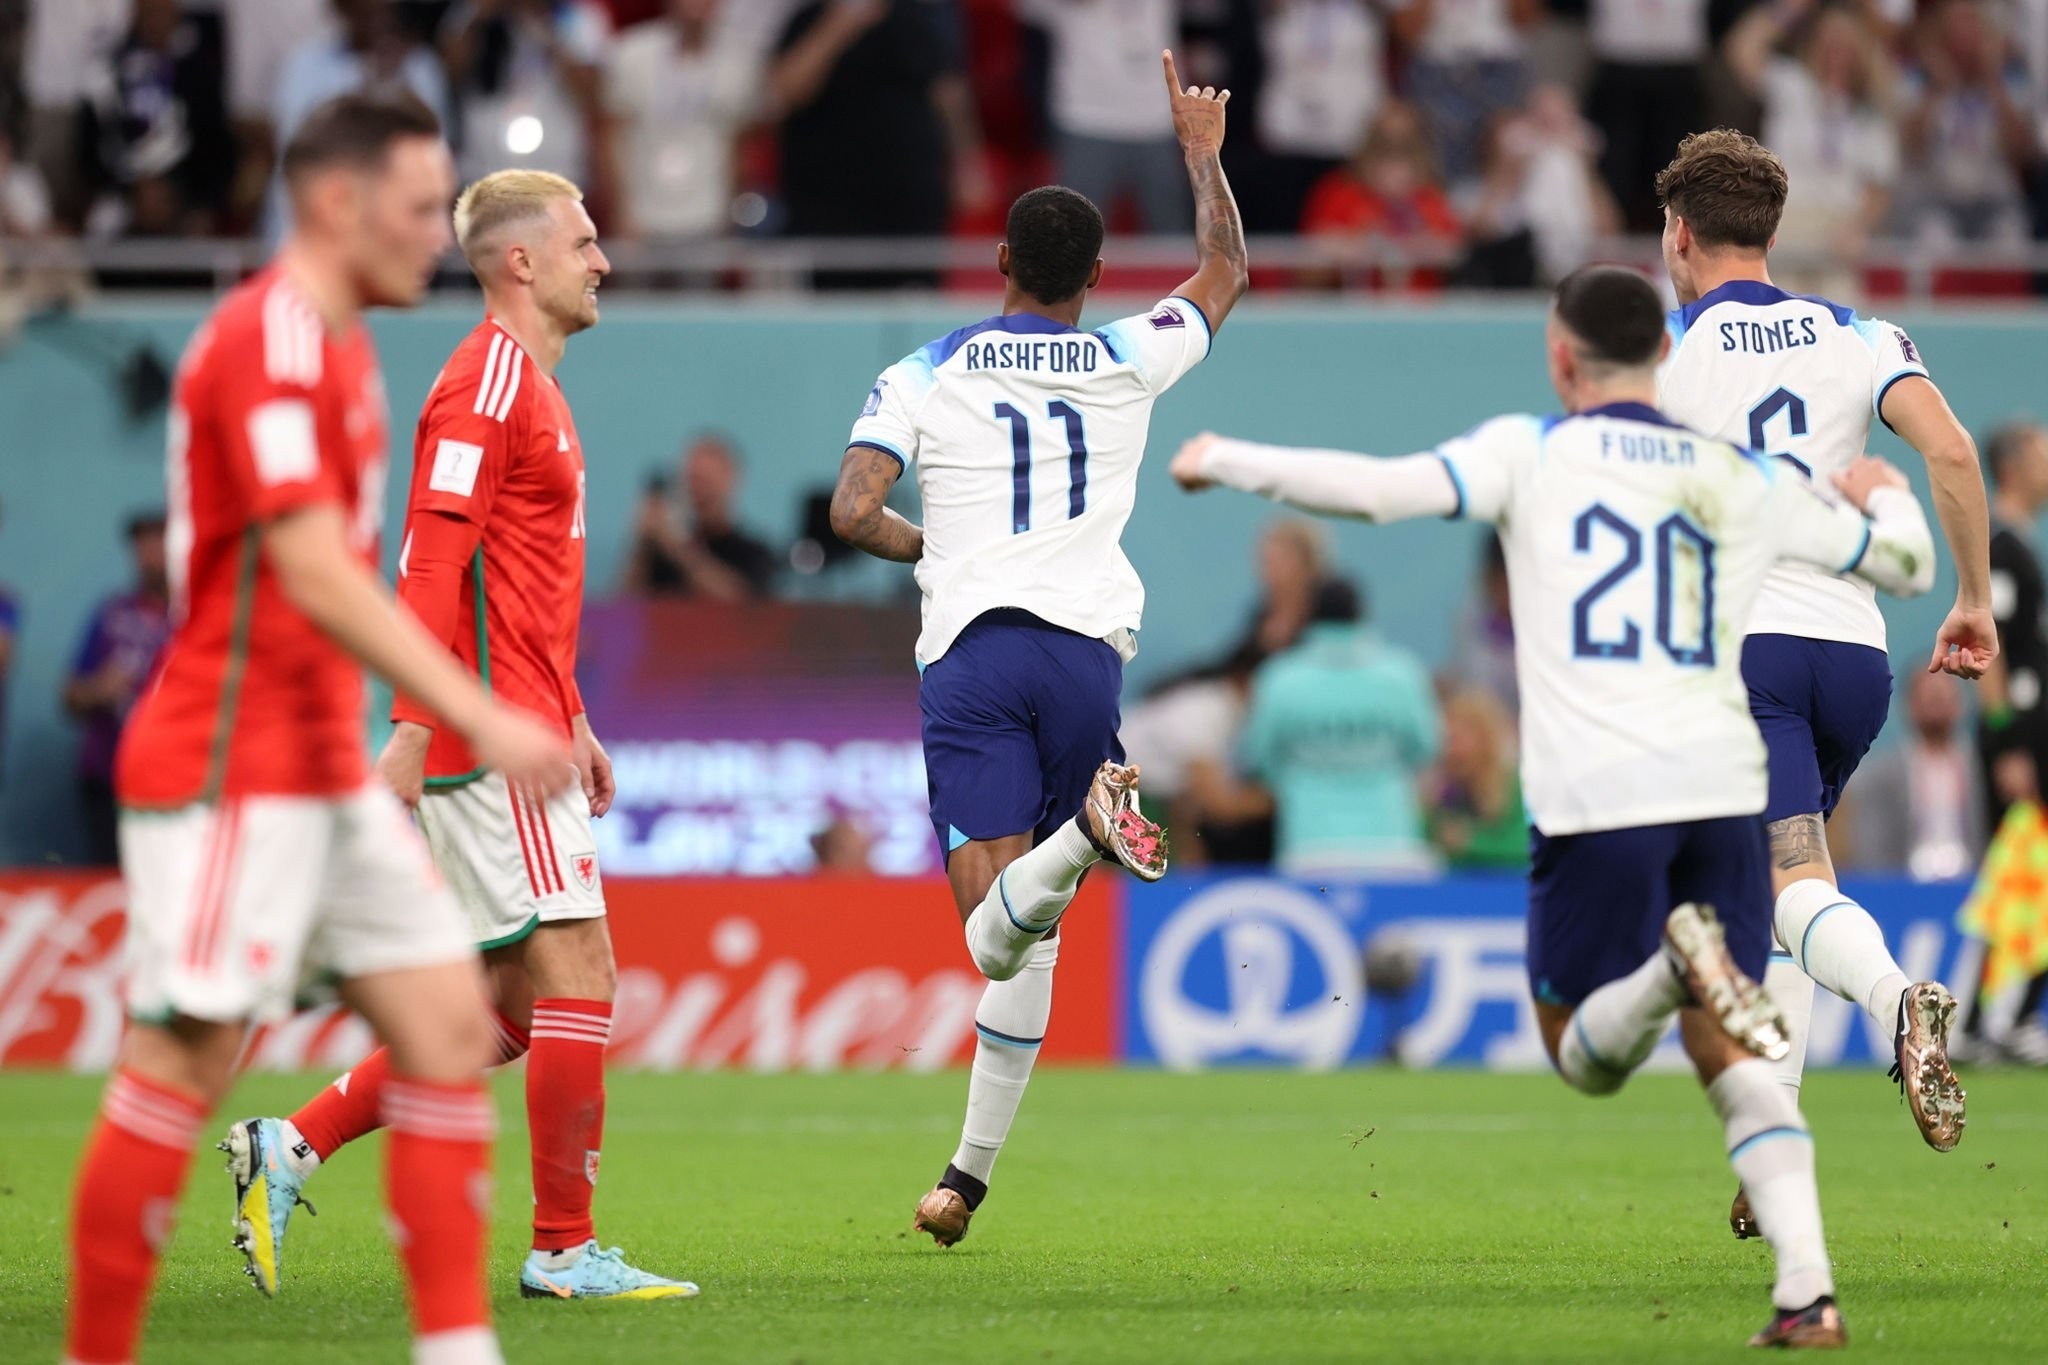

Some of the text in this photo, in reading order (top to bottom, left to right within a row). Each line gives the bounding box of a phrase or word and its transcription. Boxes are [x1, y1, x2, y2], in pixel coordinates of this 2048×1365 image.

[966, 341, 1098, 374] RASHFORD
[1719, 316, 1818, 354] STONES
[992, 397, 1089, 536] 11
[1571, 500, 1719, 668] 20
